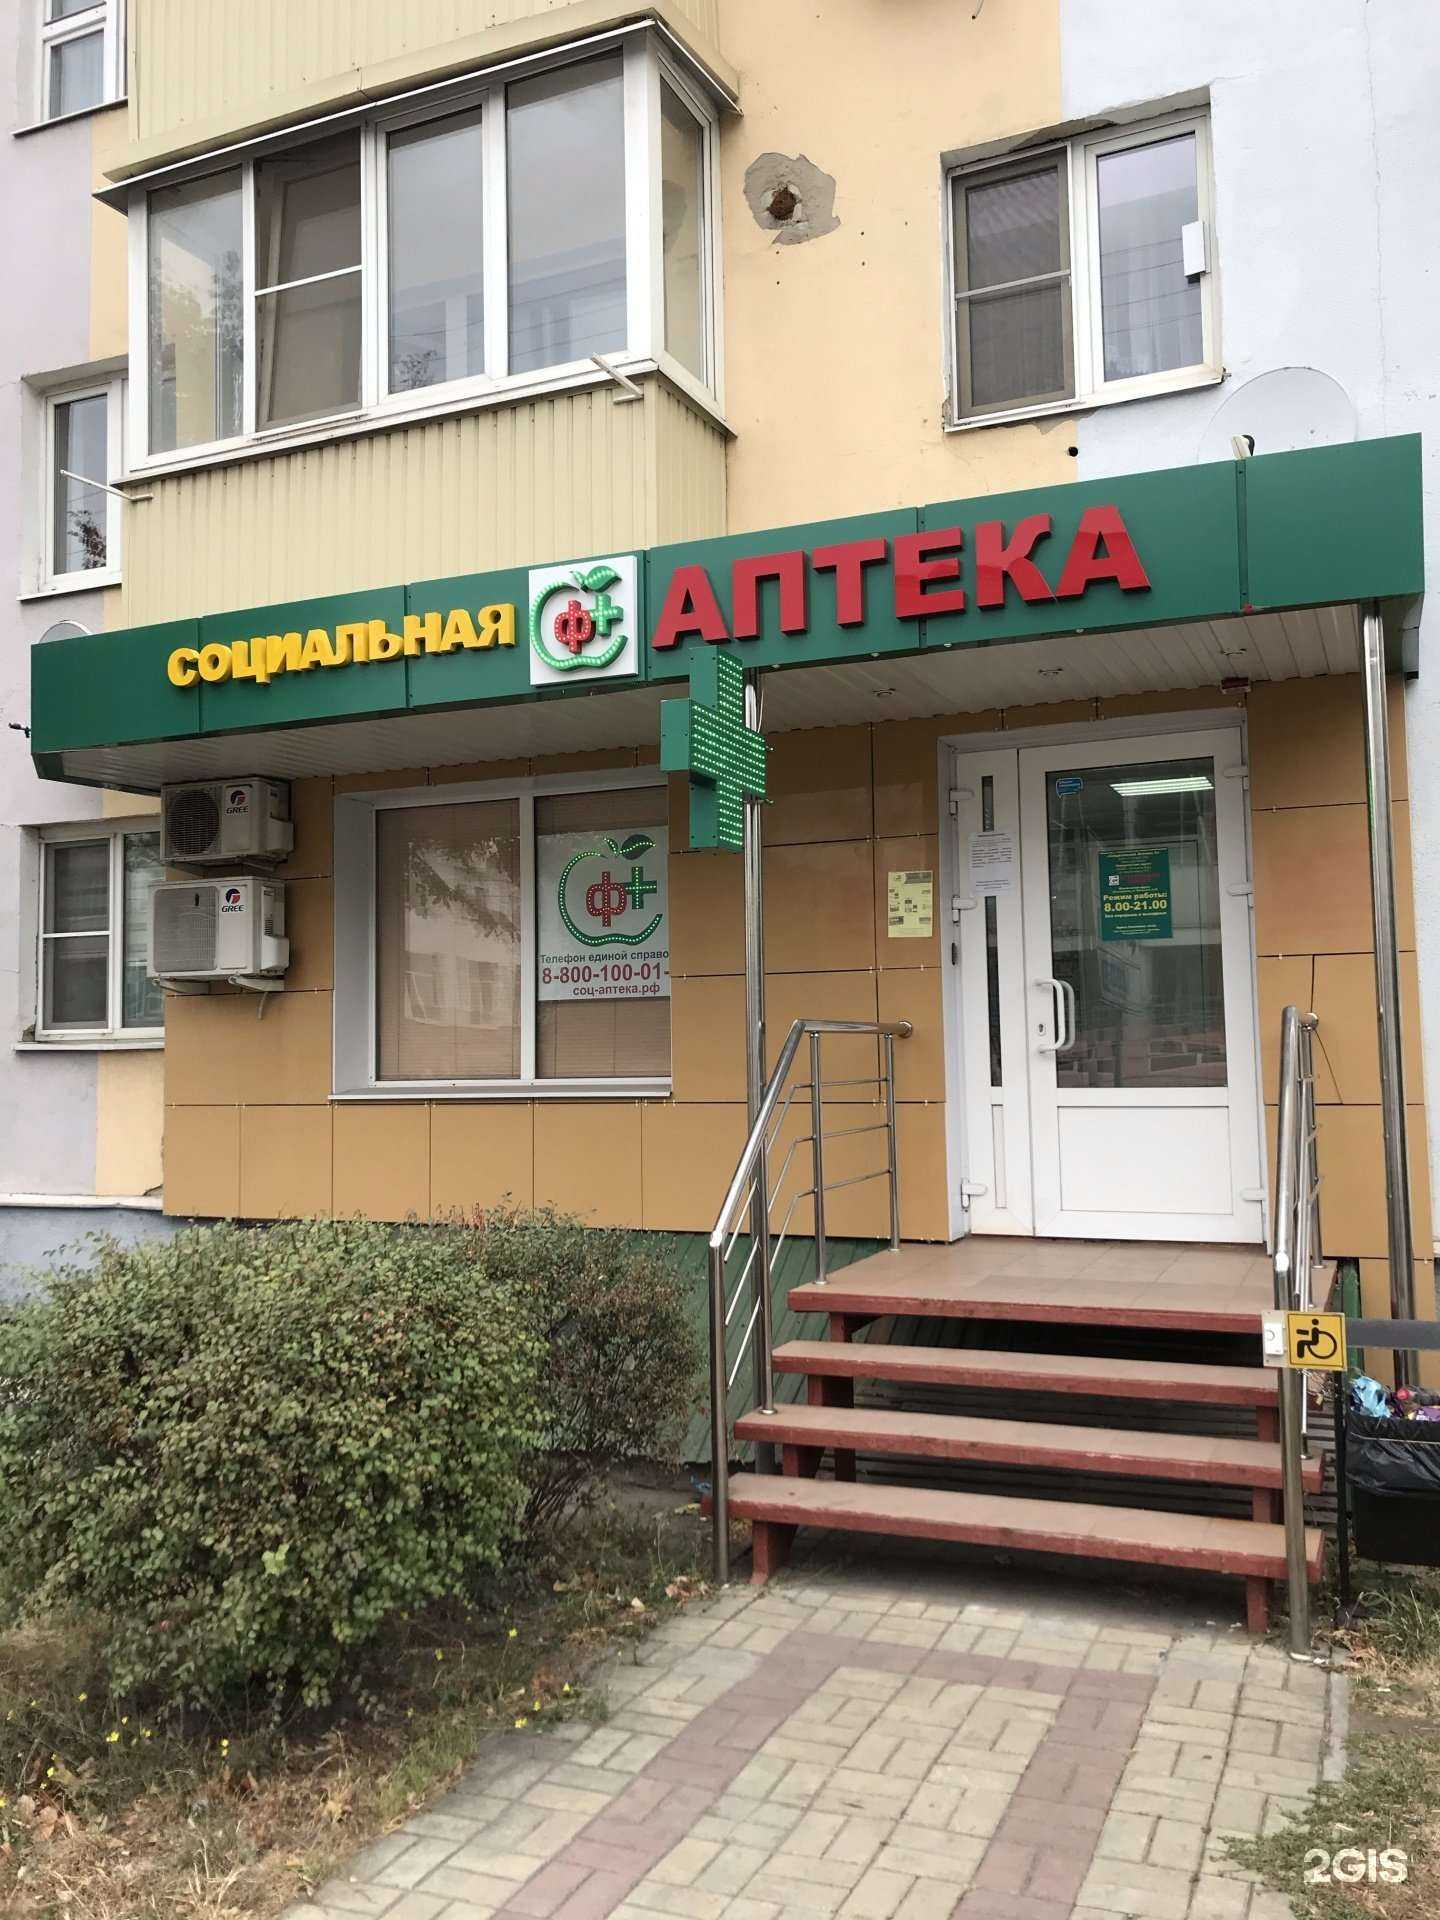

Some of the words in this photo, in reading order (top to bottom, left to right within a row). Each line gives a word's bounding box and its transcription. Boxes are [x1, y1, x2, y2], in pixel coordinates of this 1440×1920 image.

[167, 603, 516, 687] СОЦИАЛЬНАЯ
[652, 505, 1152, 650] АПТЕКА
[225, 806, 249, 815] GREE
[221, 904, 245, 913] GREE
[1104, 899, 1167, 911] 8.00-21.00
[540, 954, 586, 965] Телефон
[588, 950, 628, 963] единой
[573, 982, 661, 996] соц-аптека.рф
